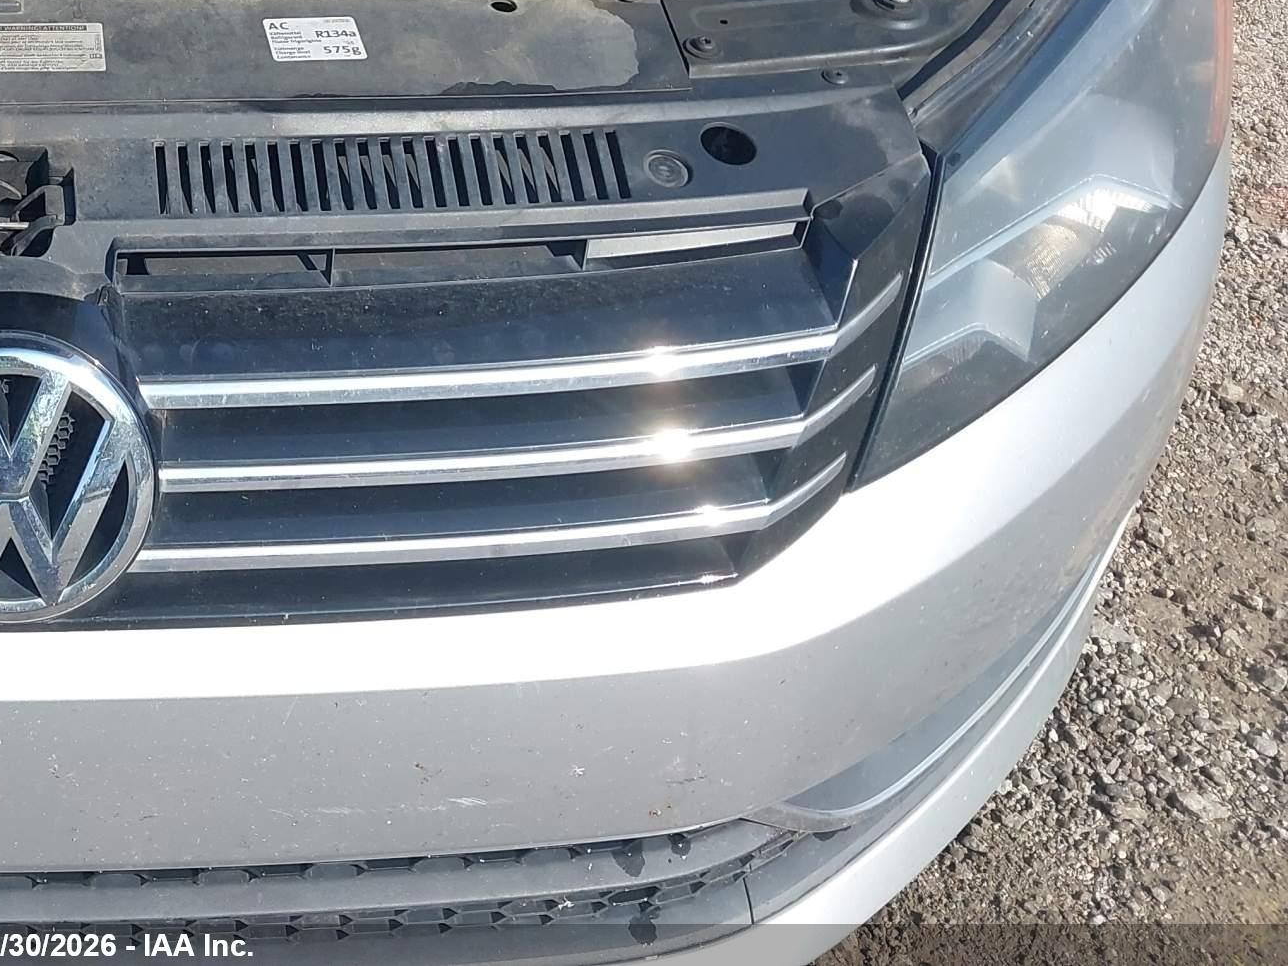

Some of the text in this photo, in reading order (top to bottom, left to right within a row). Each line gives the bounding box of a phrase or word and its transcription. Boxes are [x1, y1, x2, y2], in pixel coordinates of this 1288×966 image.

[268, 21, 289, 30] AC
[314, 30, 357, 38] R134a
[323, 45, 362, 56] 575g
